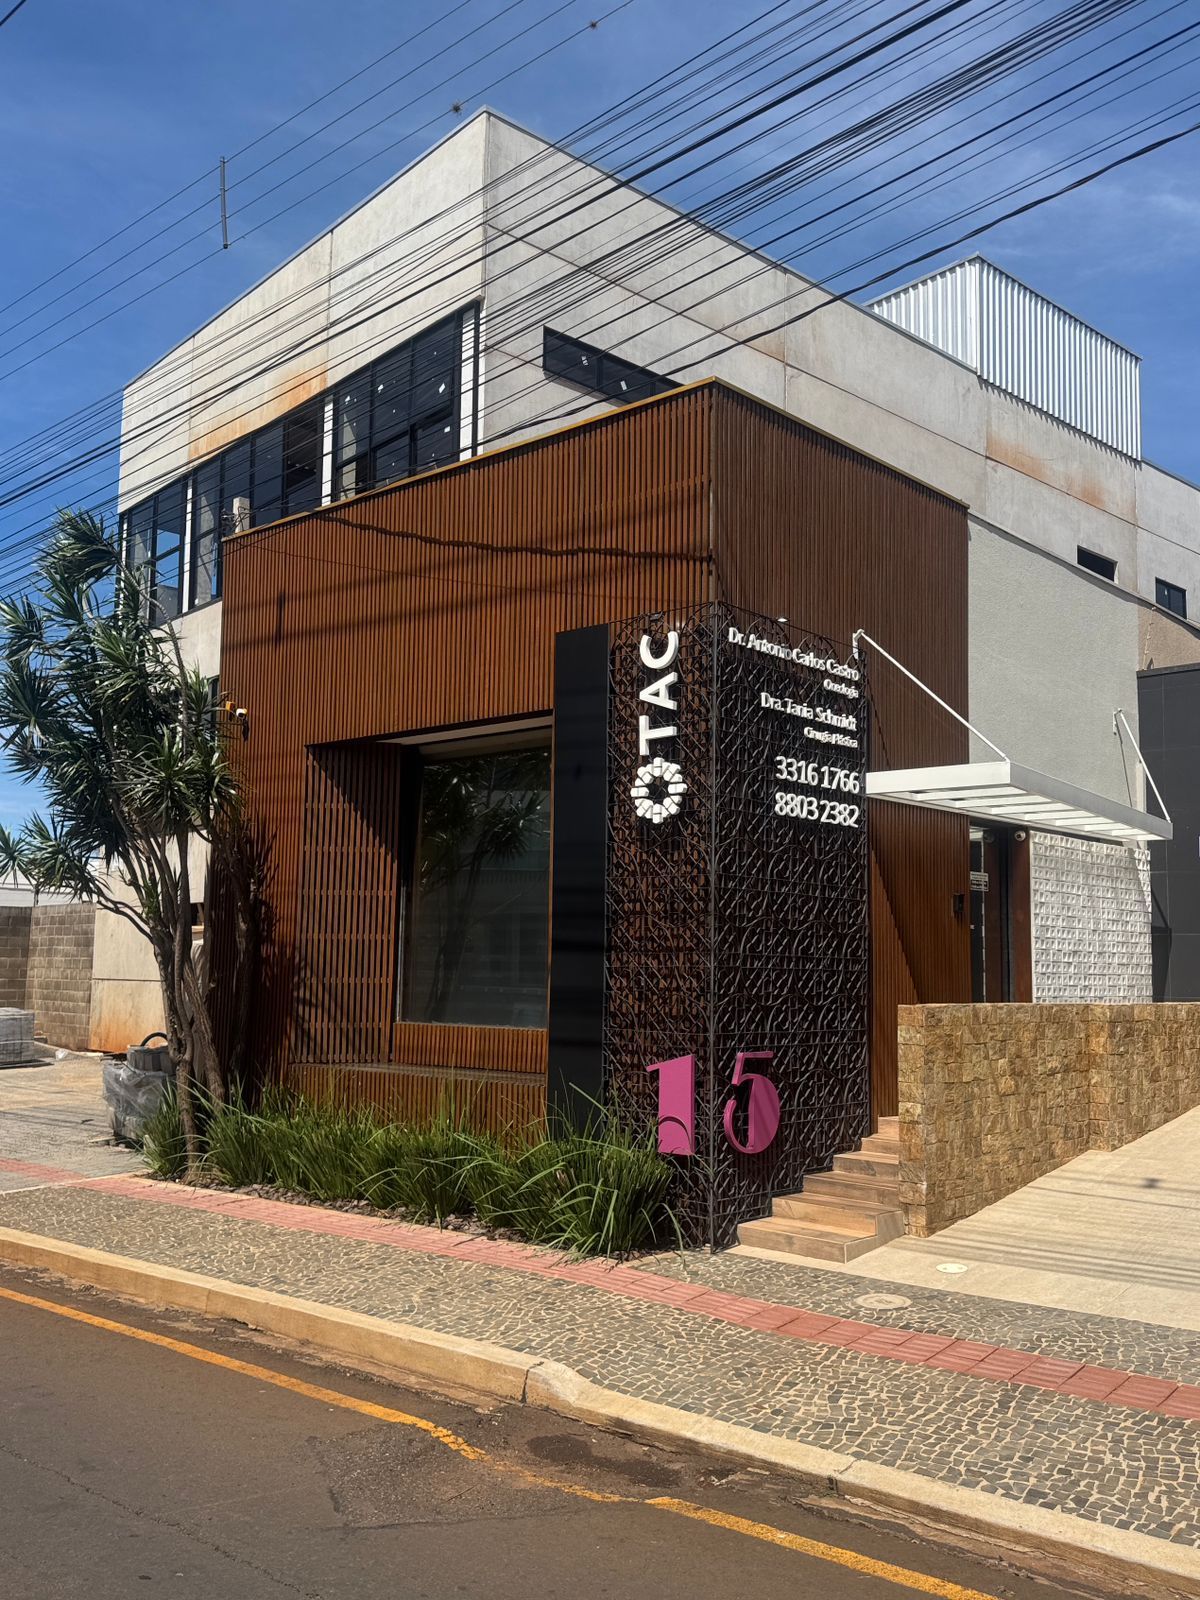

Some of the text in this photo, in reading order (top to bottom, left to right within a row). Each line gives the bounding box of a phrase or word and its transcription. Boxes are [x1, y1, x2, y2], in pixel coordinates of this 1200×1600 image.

[728, 627, 860, 681] Dr. Antonio Carlos Castro
[760, 692, 857, 732] Dra. Tania Schmidt
[775, 756, 860, 794] 3316 1766
[775, 792, 859, 828] 8803 2382
